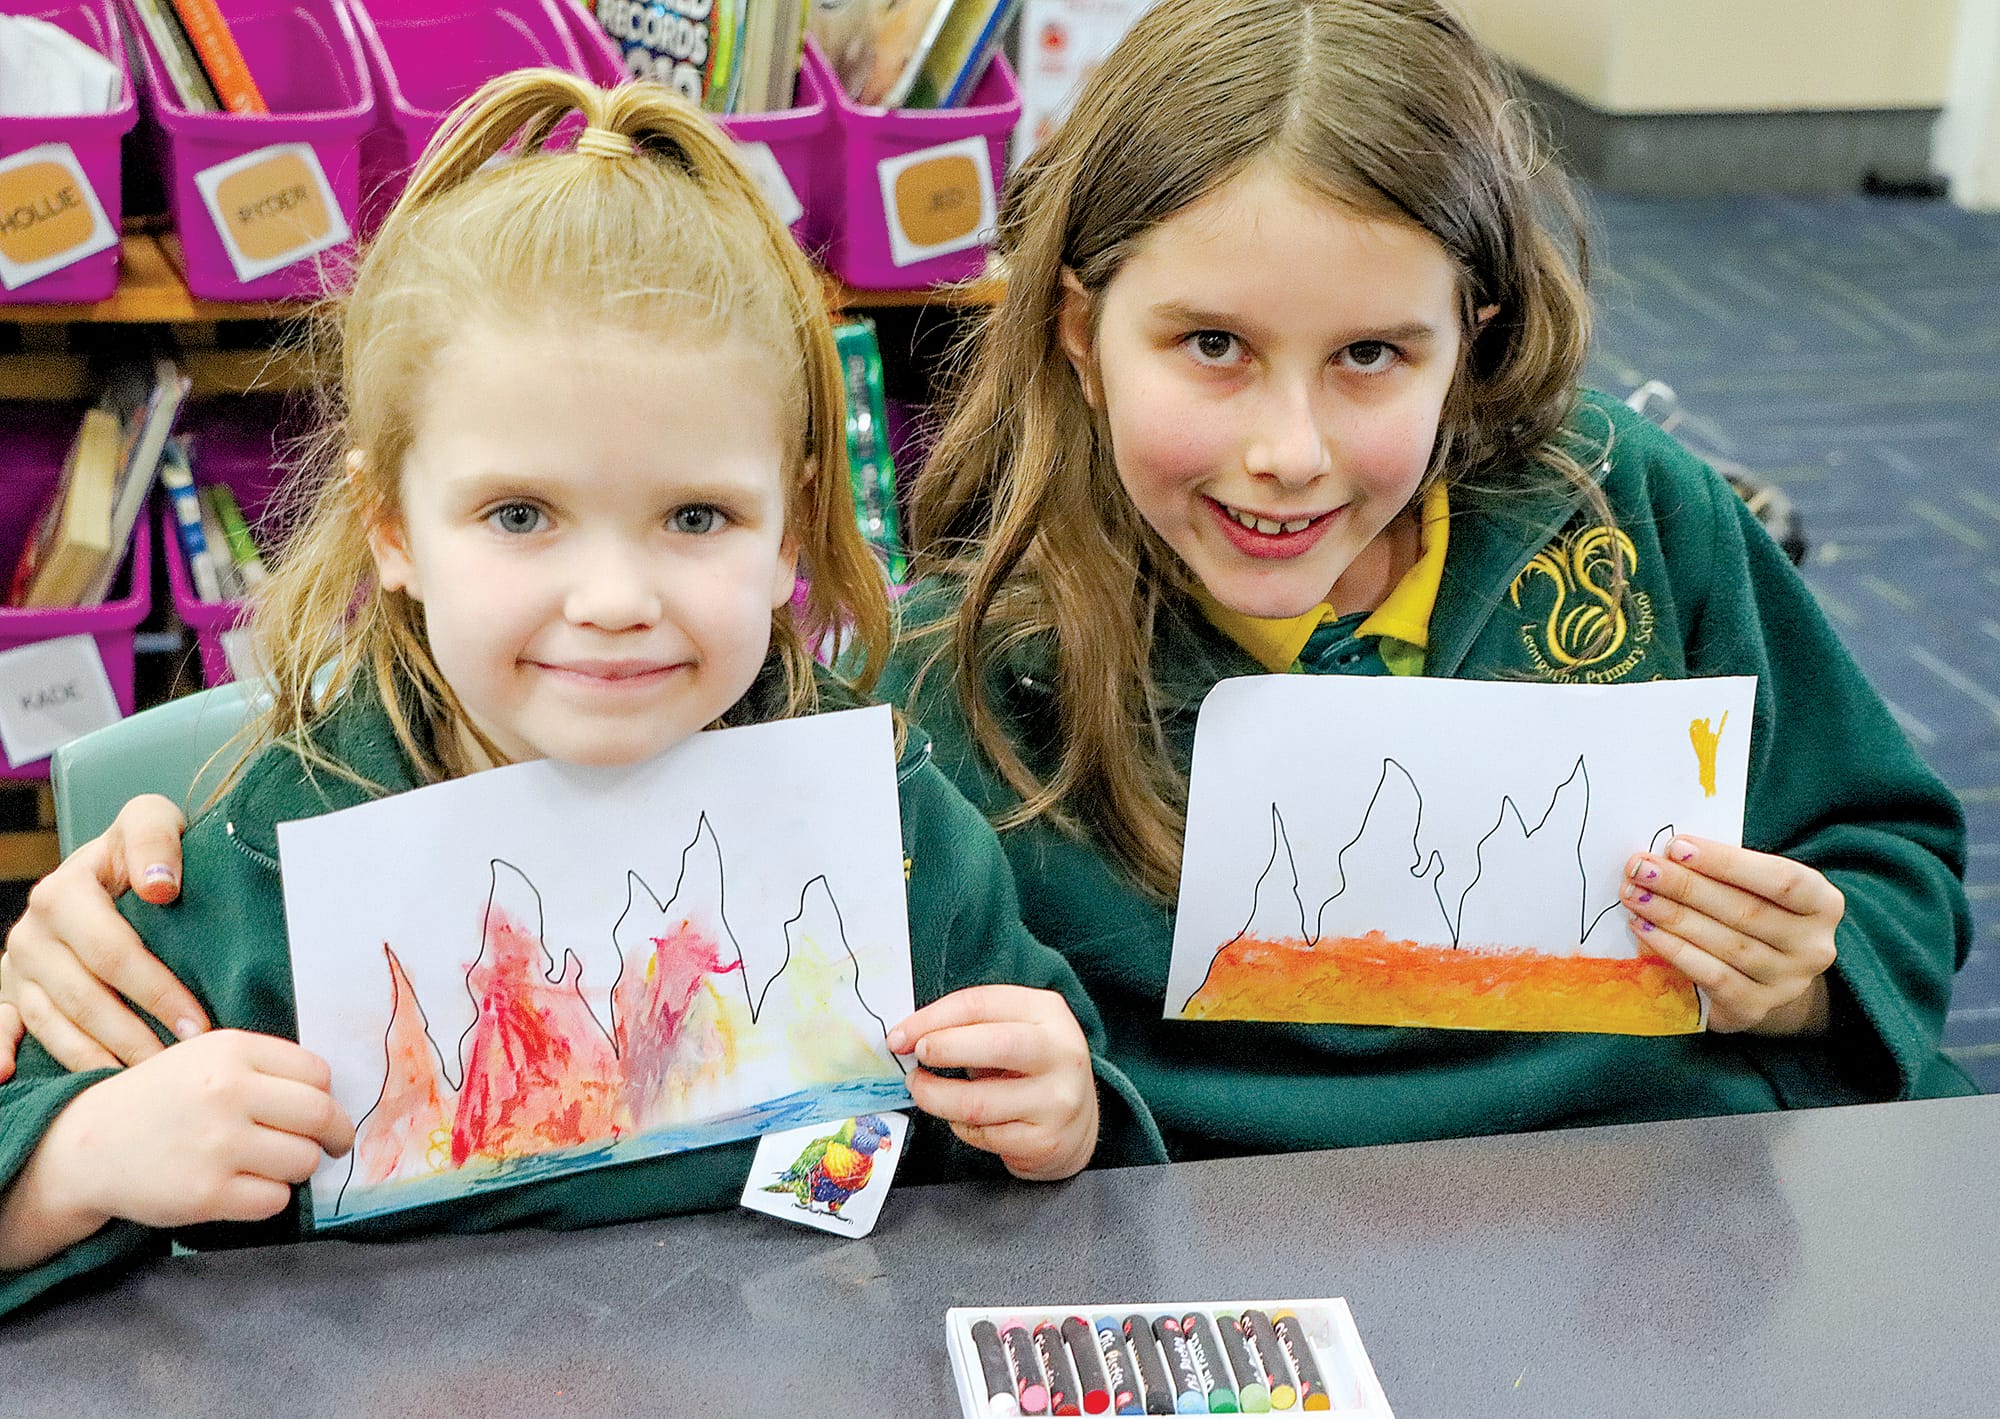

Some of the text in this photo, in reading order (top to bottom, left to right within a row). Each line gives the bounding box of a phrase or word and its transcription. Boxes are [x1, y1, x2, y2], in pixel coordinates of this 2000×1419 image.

[597, 0, 708, 65] RECORDS
[1585, 647, 1646, 683] Primary
[1632, 592, 1654, 644] School
